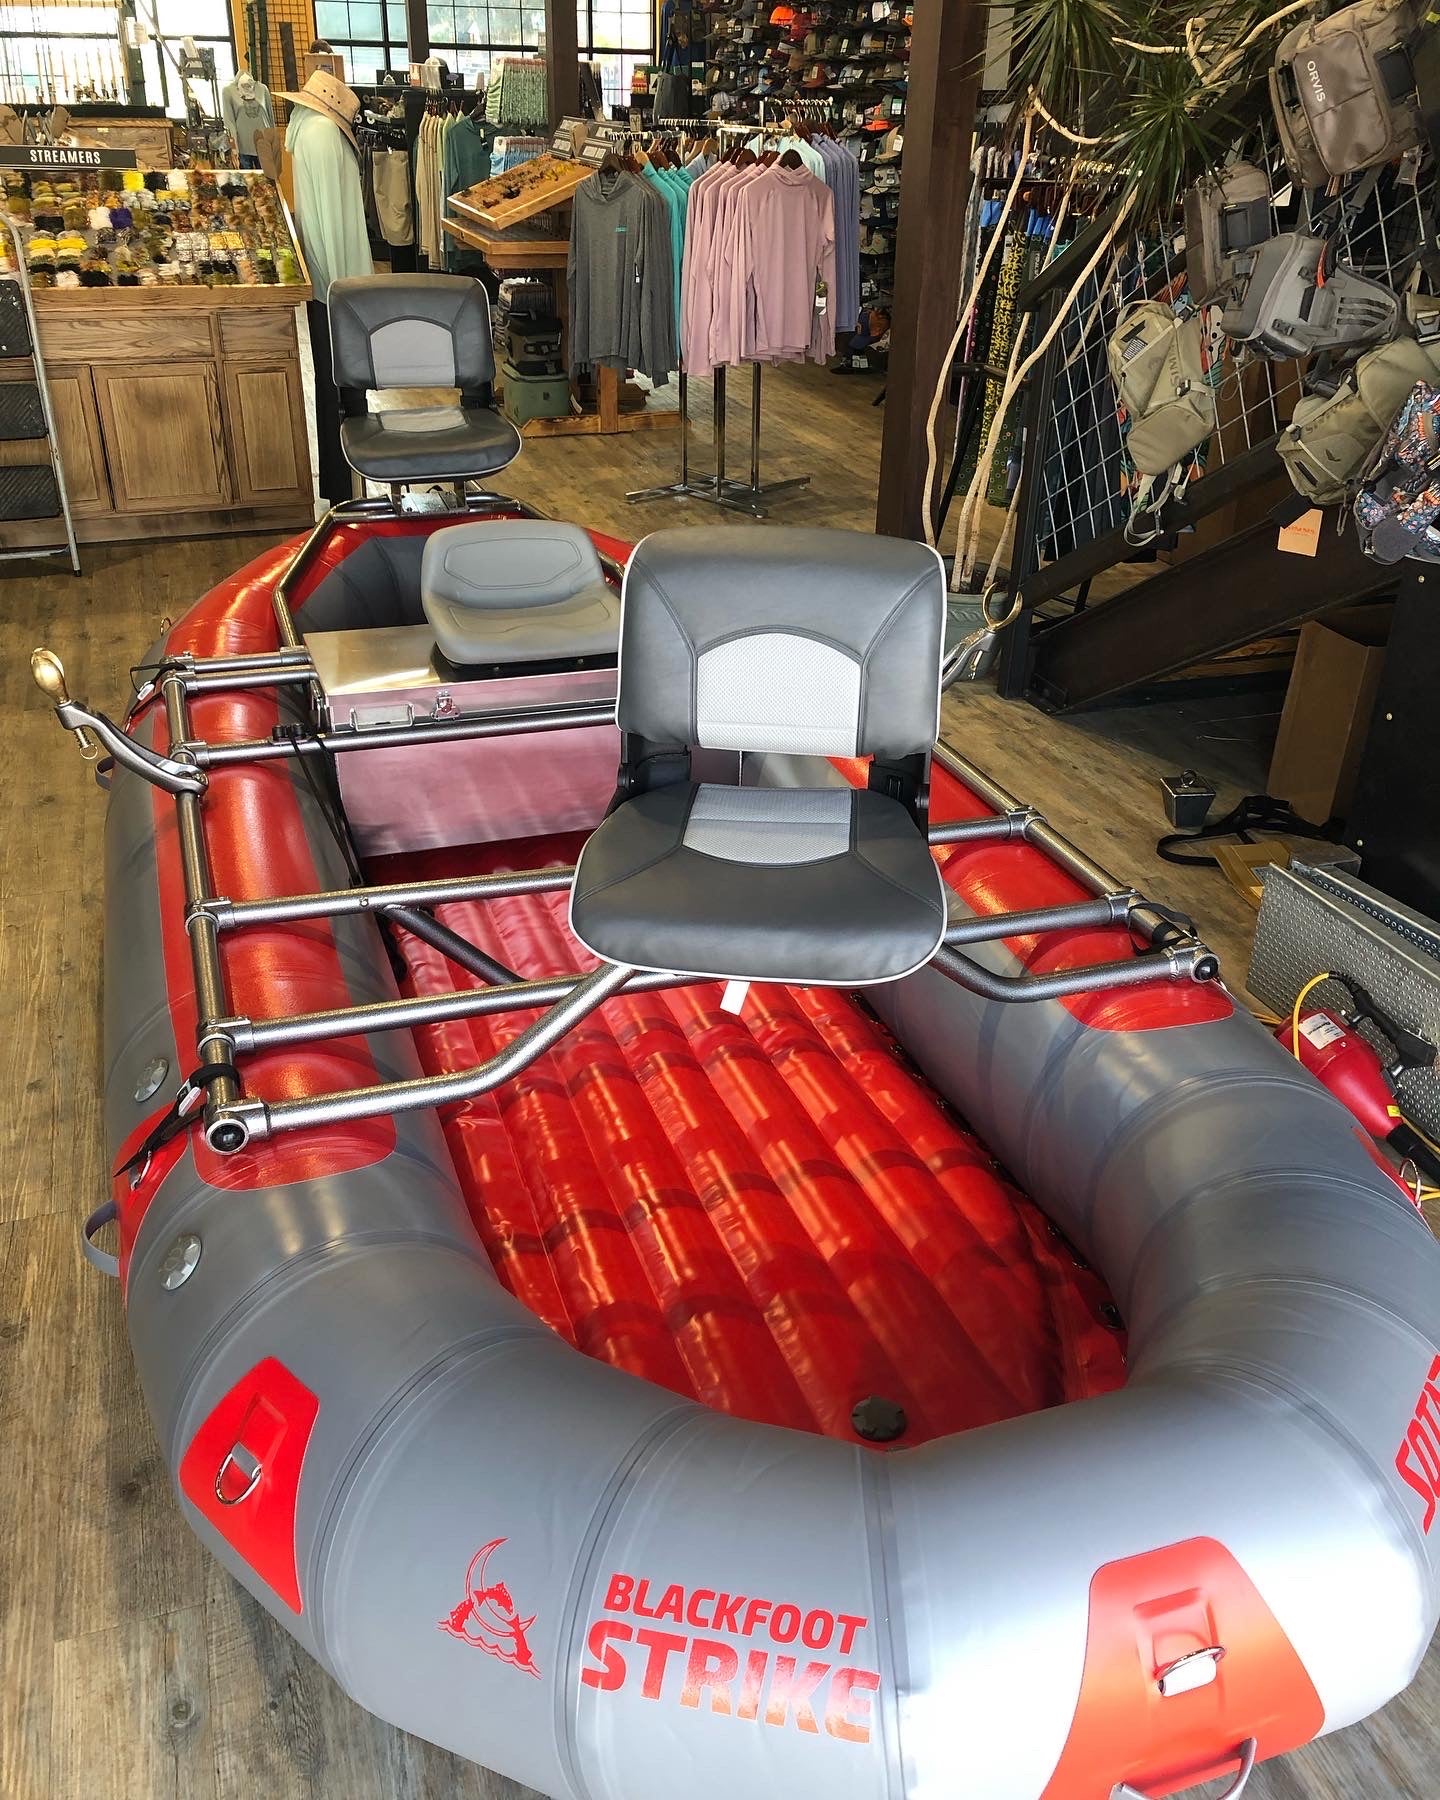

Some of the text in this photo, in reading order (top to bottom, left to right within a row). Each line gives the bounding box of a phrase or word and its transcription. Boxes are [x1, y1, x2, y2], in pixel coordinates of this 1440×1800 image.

[1307, 60, 1326, 102] ORVIS
[29, 149, 101, 164] STREAMERS
[603, 1572, 868, 1655] BLACKFOOT
[581, 1618, 881, 1744] STRIKE
